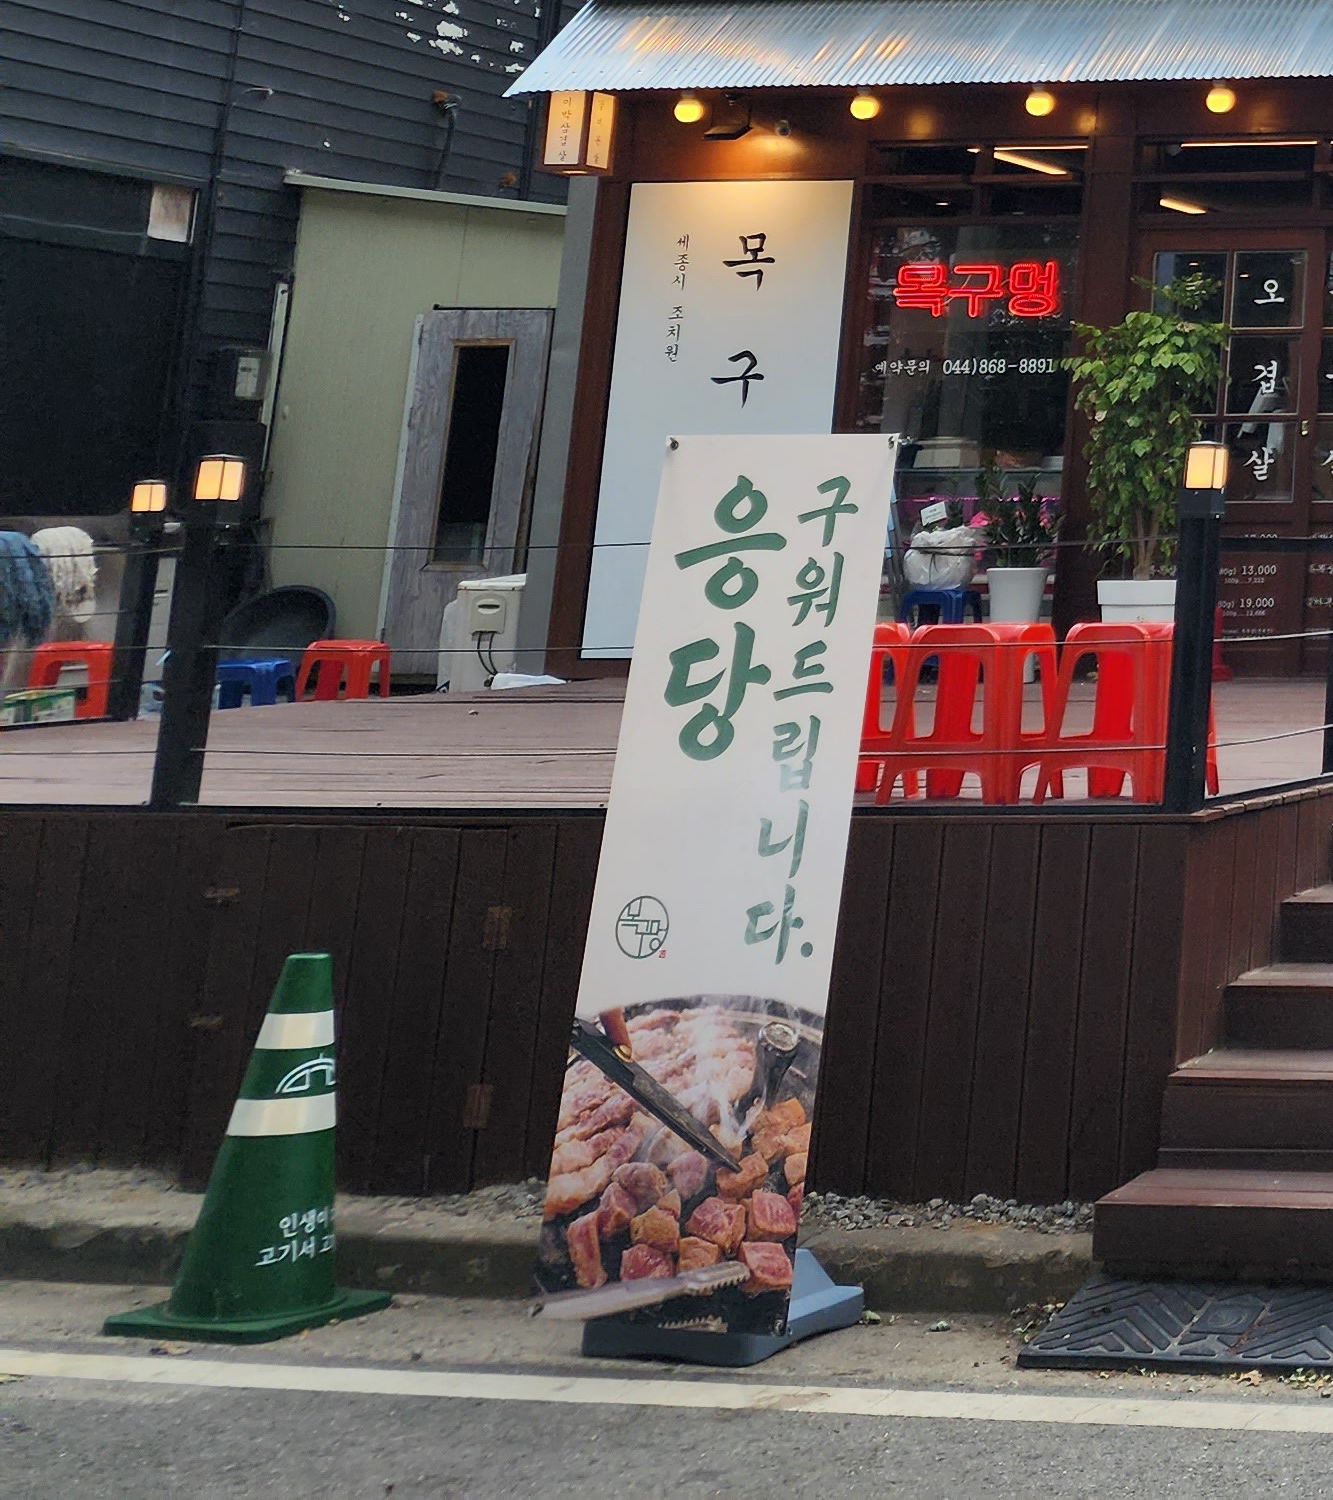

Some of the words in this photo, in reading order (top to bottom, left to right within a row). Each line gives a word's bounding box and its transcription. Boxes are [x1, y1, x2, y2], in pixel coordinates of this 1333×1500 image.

[671, 233, 690, 291] 세종시
[893, 260, 1060, 319] 목구멍
[664, 305, 684, 363] 조치원
[874, 358, 931, 376] 예약문의
[942, 357, 1056, 377] 044)868-8891
[663, 473, 788, 762] 응당
[1239, 598, 1275, 609] 19,000
[254, 1235, 316, 1267] 고기서
